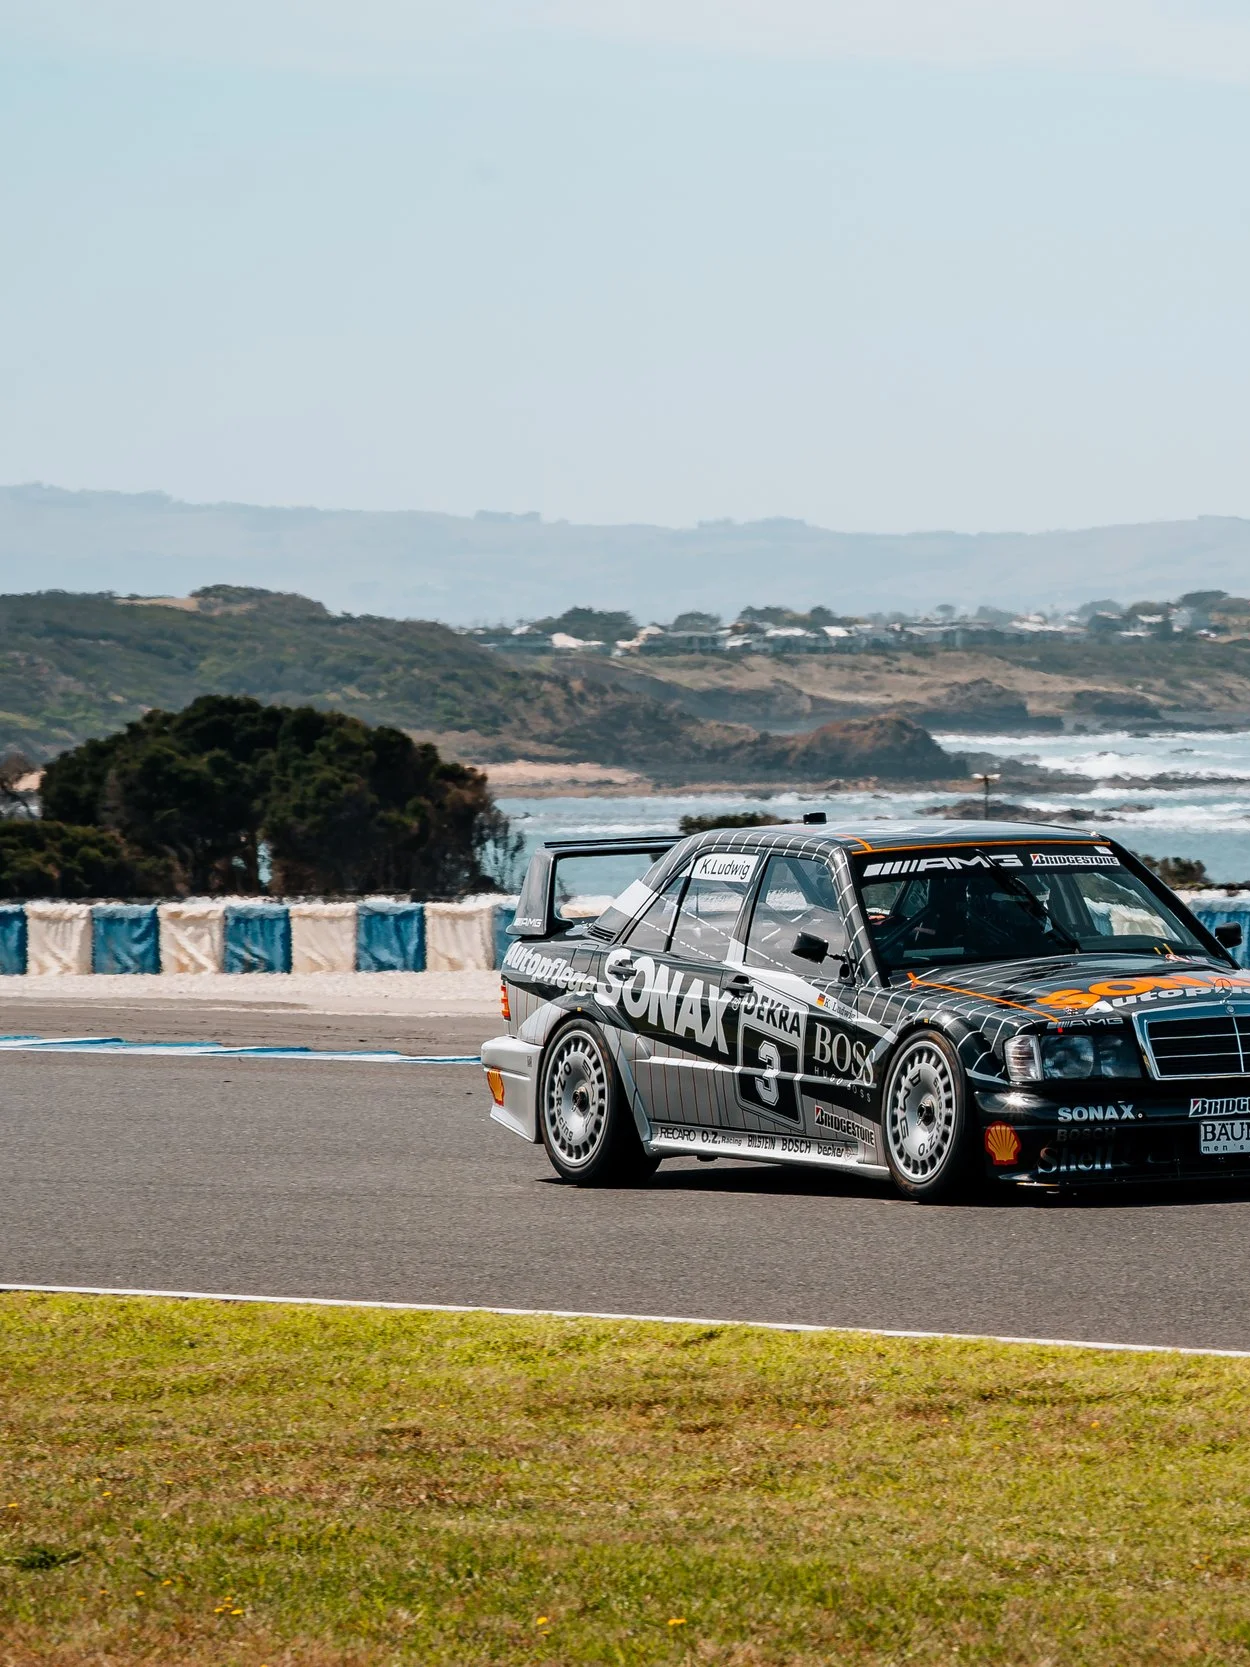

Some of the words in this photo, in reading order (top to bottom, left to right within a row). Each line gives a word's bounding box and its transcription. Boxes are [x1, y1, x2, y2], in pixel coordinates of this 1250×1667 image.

[917, 854, 1024, 872] AMG
[1032, 853, 1119, 866] BRIDGESTONE
[519, 917, 543, 928] AMG
[503, 941, 597, 993] Autopflege
[594, 948, 729, 1055] SONAX
[743, 991, 801, 1038] DEKRA
[1069, 1017, 1124, 1028] AMG
[812, 1022, 876, 1087] BOSS
[755, 1040, 780, 1106] 3
[1057, 1104, 1136, 1122] SONAX
[815, 1105, 875, 1147] BRIDGESTONE
[1056, 1127, 1117, 1142] BOSCH
[660, 1127, 697, 1142] RECARO
[747, 1134, 776, 1150] BILSTEIN
[781, 1138, 811, 1155] BOSCH
[817, 1142, 845, 1158] becker
[1202, 1143, 1245, 1153] men's
